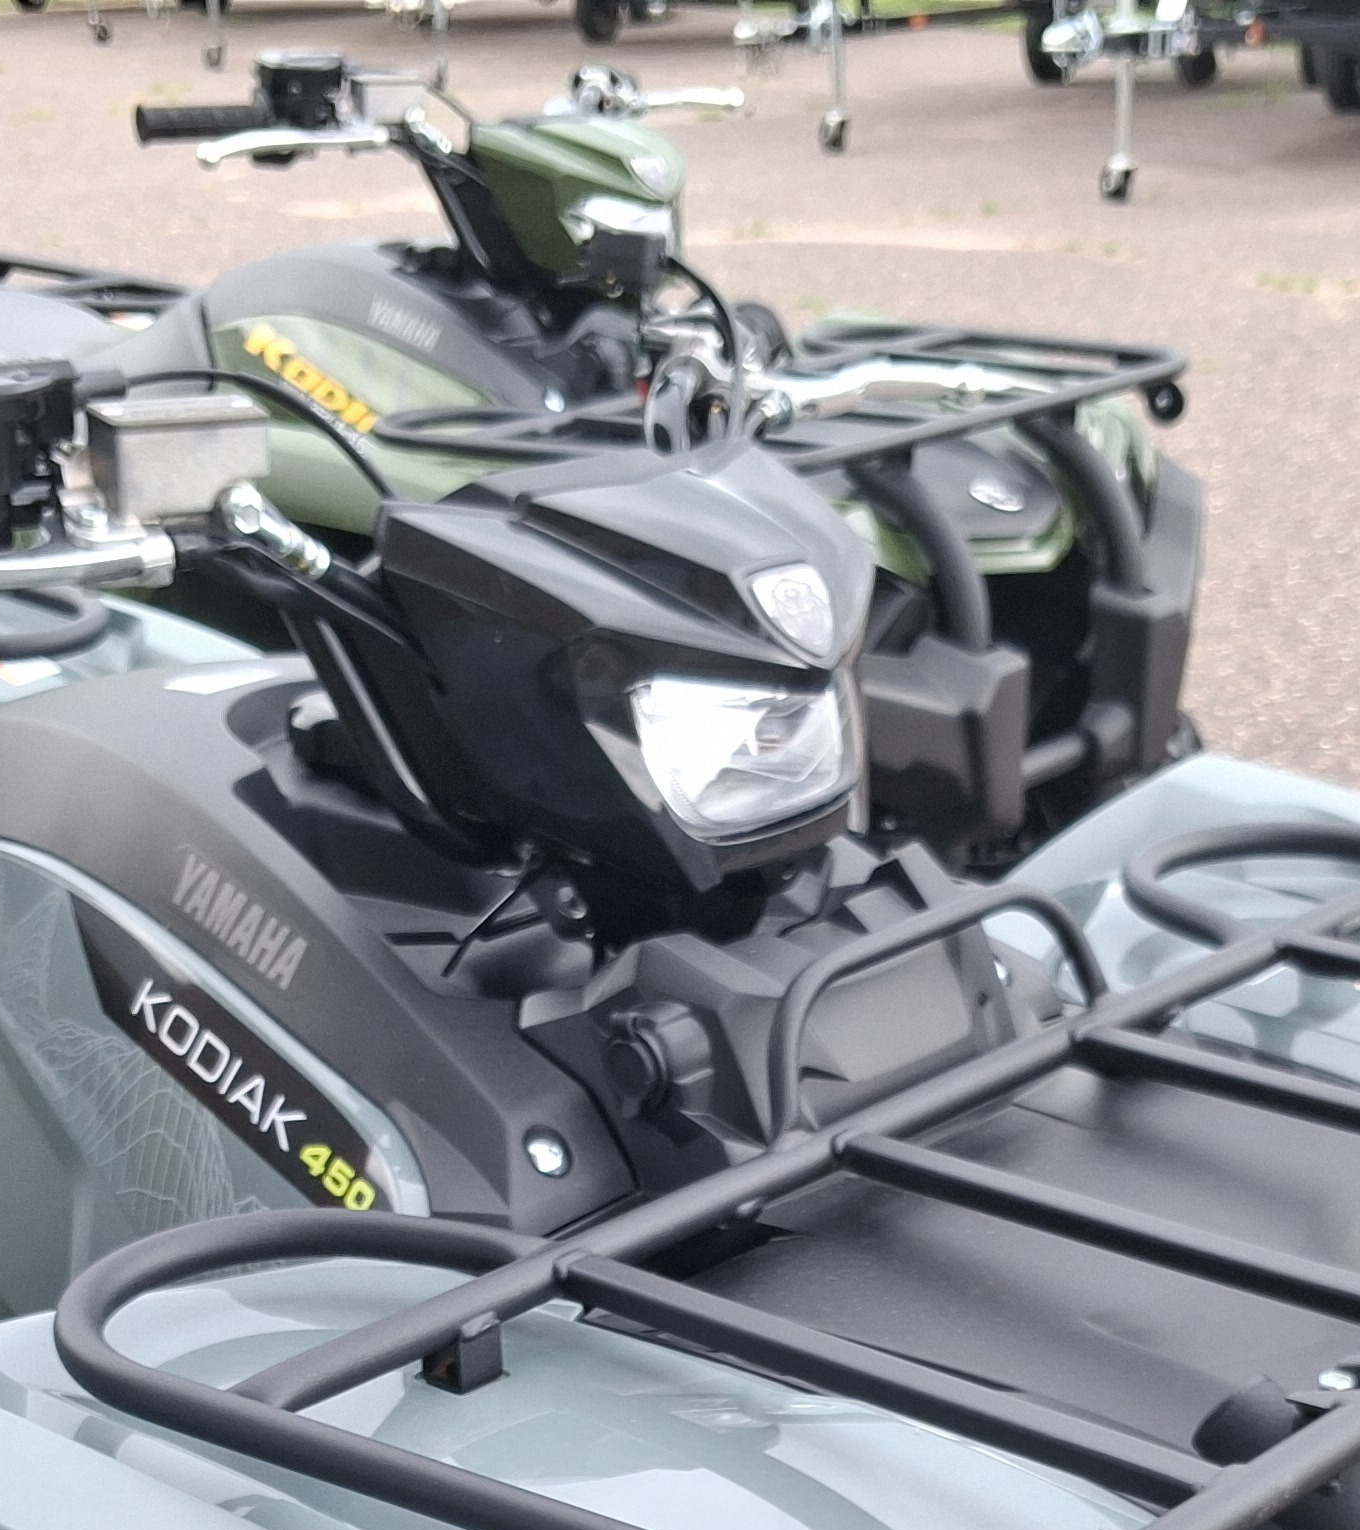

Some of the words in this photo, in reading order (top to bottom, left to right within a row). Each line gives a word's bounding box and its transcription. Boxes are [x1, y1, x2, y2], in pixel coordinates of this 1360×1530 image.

[172, 853, 309, 990] YAMAHA
[130, 978, 308, 1153] KODIAK
[299, 1143, 376, 1211] 450
